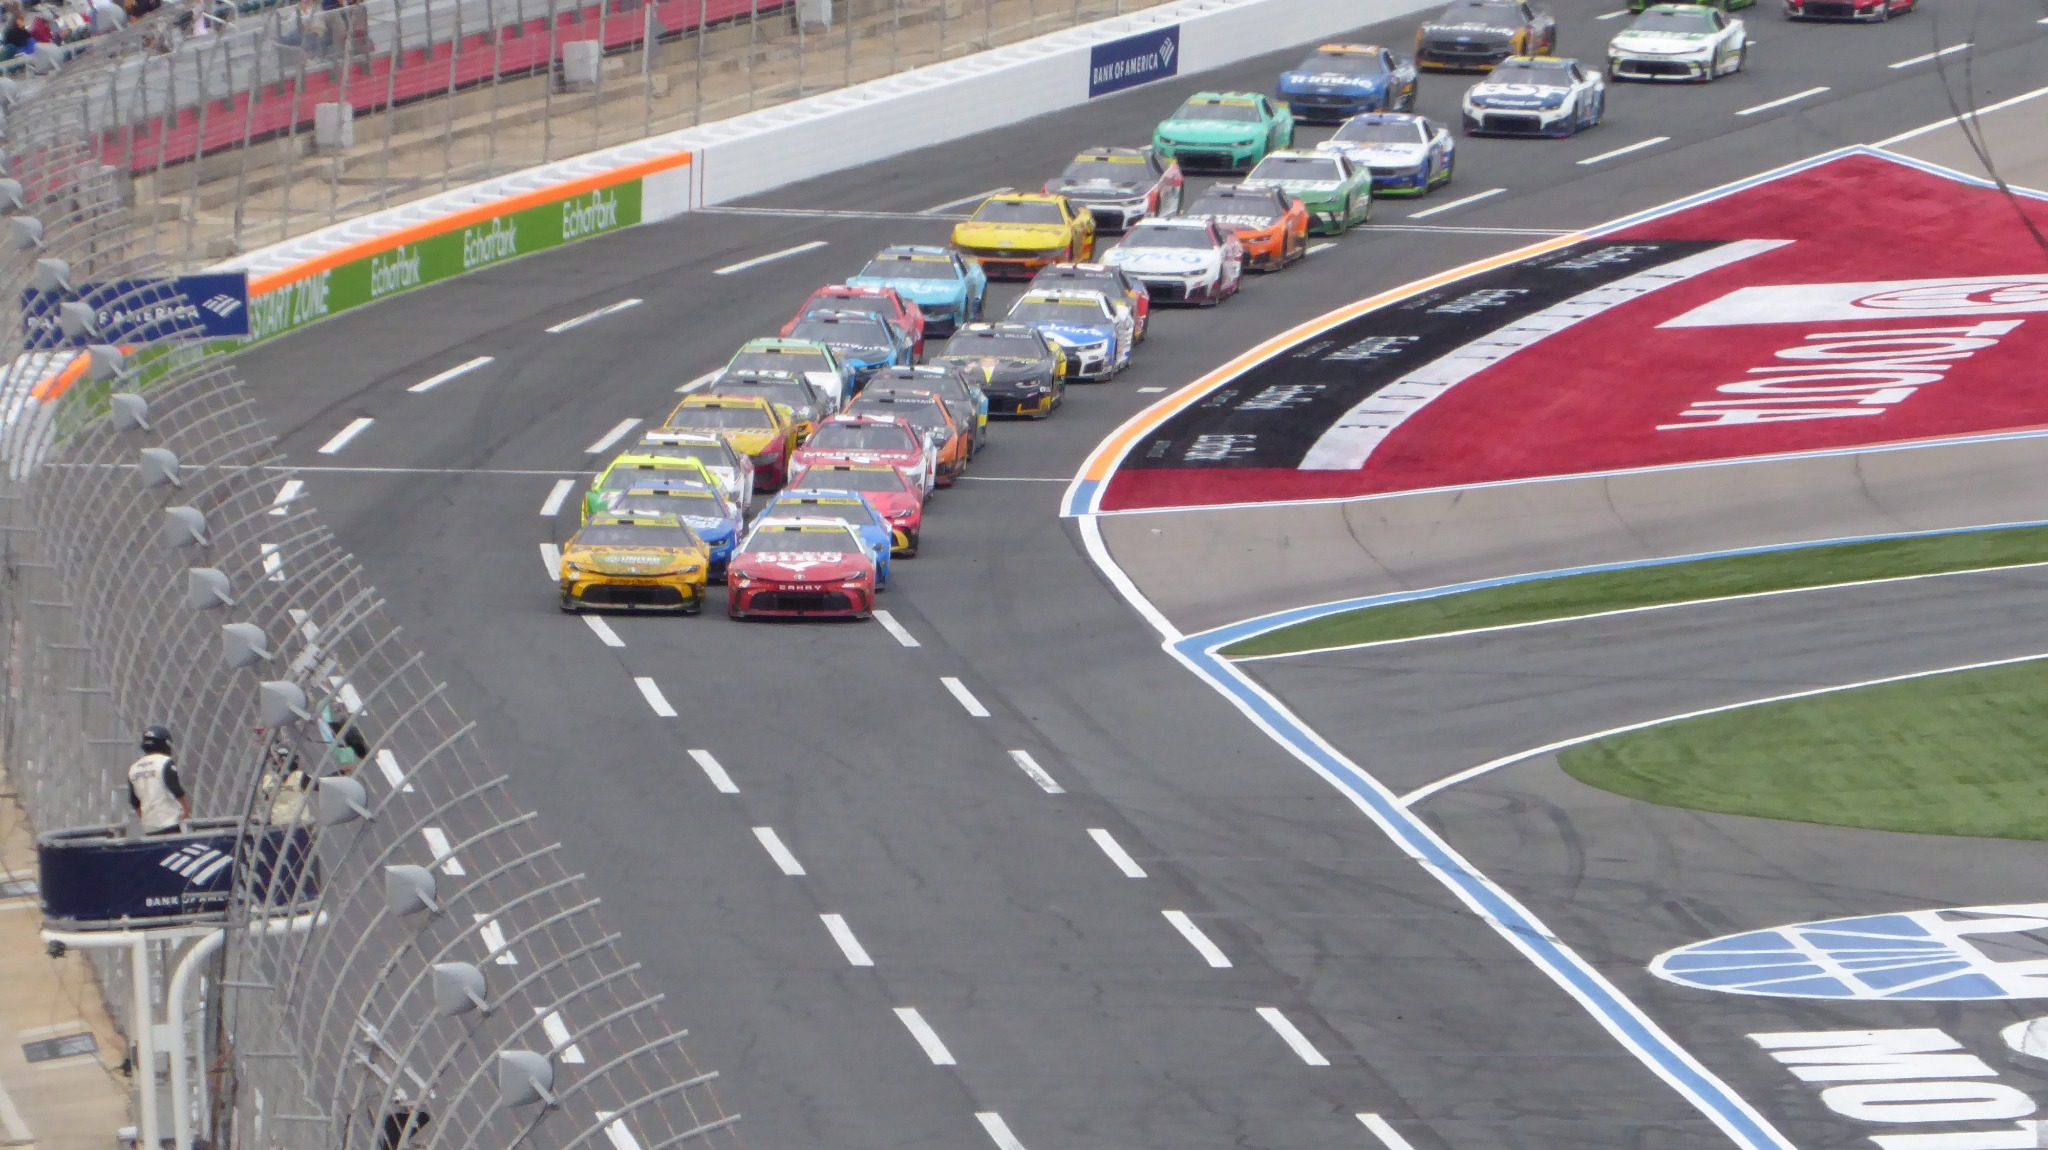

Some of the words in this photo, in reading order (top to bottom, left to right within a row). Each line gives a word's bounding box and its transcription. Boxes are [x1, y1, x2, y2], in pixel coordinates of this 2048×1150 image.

[1093, 63, 1114, 85] BANK
[1115, 60, 1125, 79] OF
[1125, 52, 1158, 76] AMERICA
[1289, 75, 1373, 88] Trimble
[562, 189, 618, 240] EchoPark
[463, 217, 517, 269] EchoPark
[293, 268, 331, 325] ZONE
[371, 245, 421, 297] EchoPark
[1656, 319, 2026, 431] TOYOTA
[1338, 380, 1449, 430] ZONE
[146, 896, 178, 908] BANK
